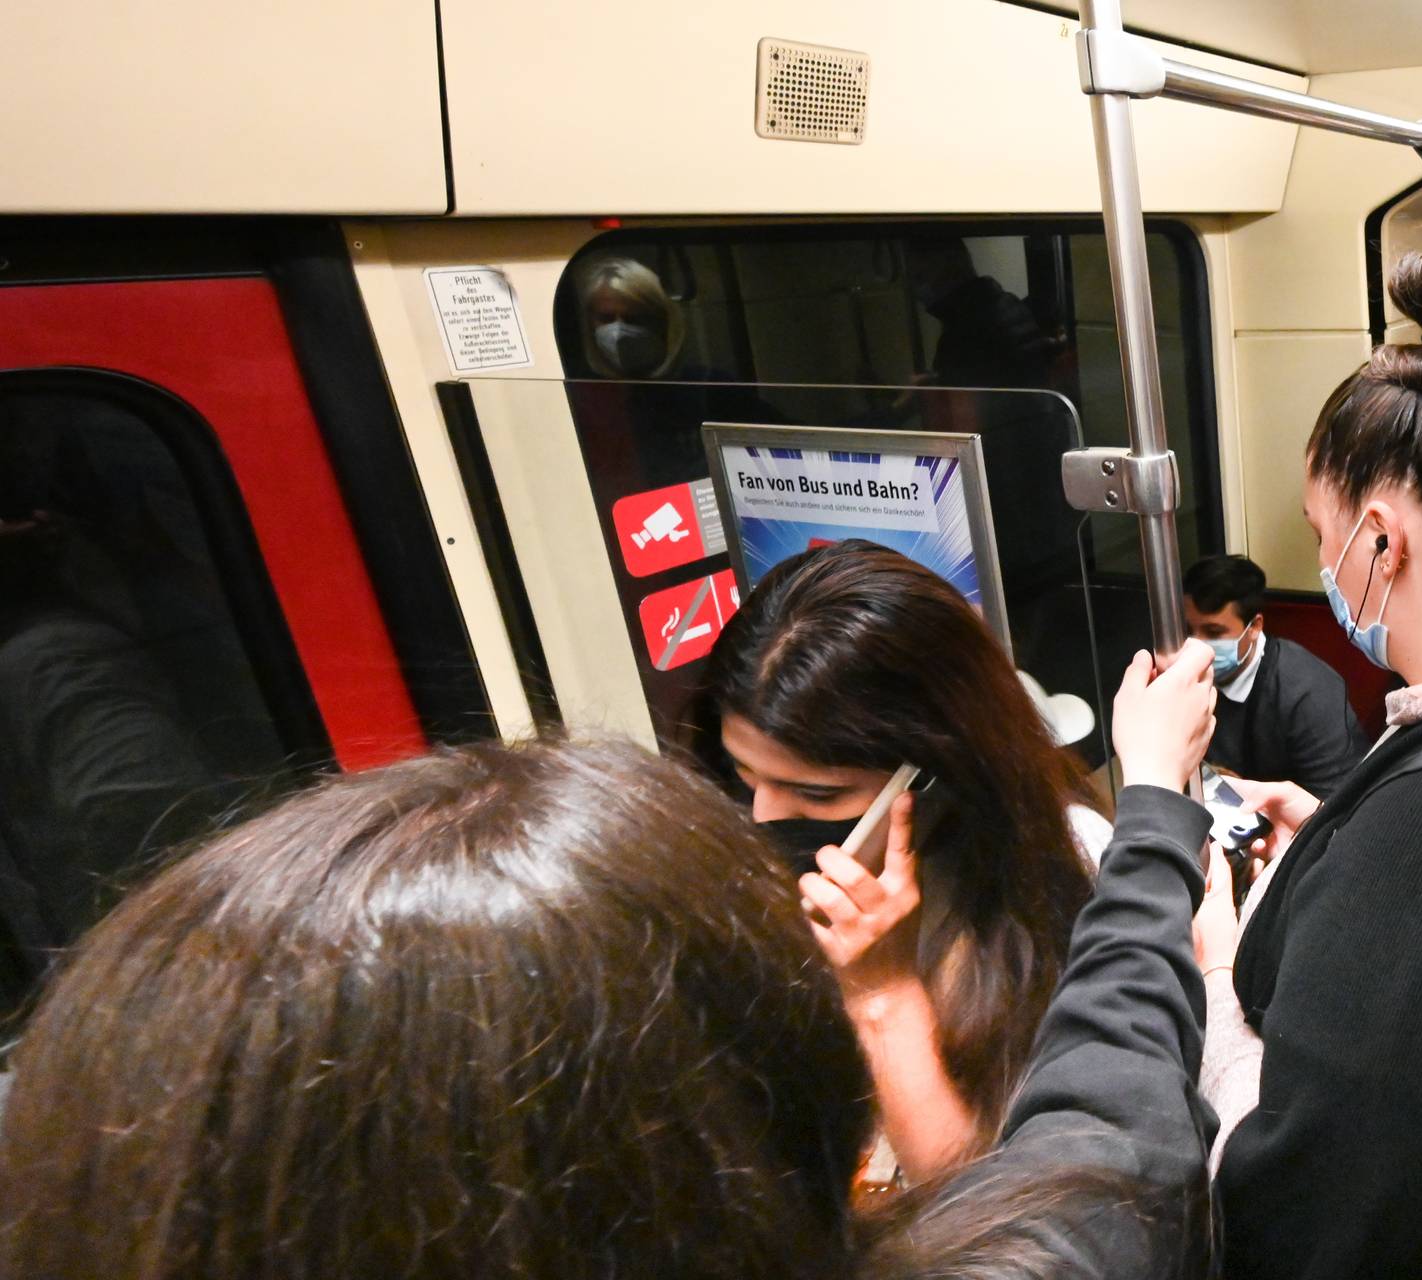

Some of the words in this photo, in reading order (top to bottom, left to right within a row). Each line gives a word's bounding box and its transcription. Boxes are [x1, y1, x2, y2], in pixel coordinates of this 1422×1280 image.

[454, 275, 482, 286] Pflicht
[452, 294, 496, 306] Fahrgastes
[738, 471, 764, 491] Fan
[767, 477, 795, 493] von
[799, 475, 829, 495] Bus
[833, 479, 864, 497] und
[868, 480, 919, 501] Bahn?
[822, 503, 834, 511] und
[835, 504, 857, 512] sichern
[858, 505, 871, 513] sich
